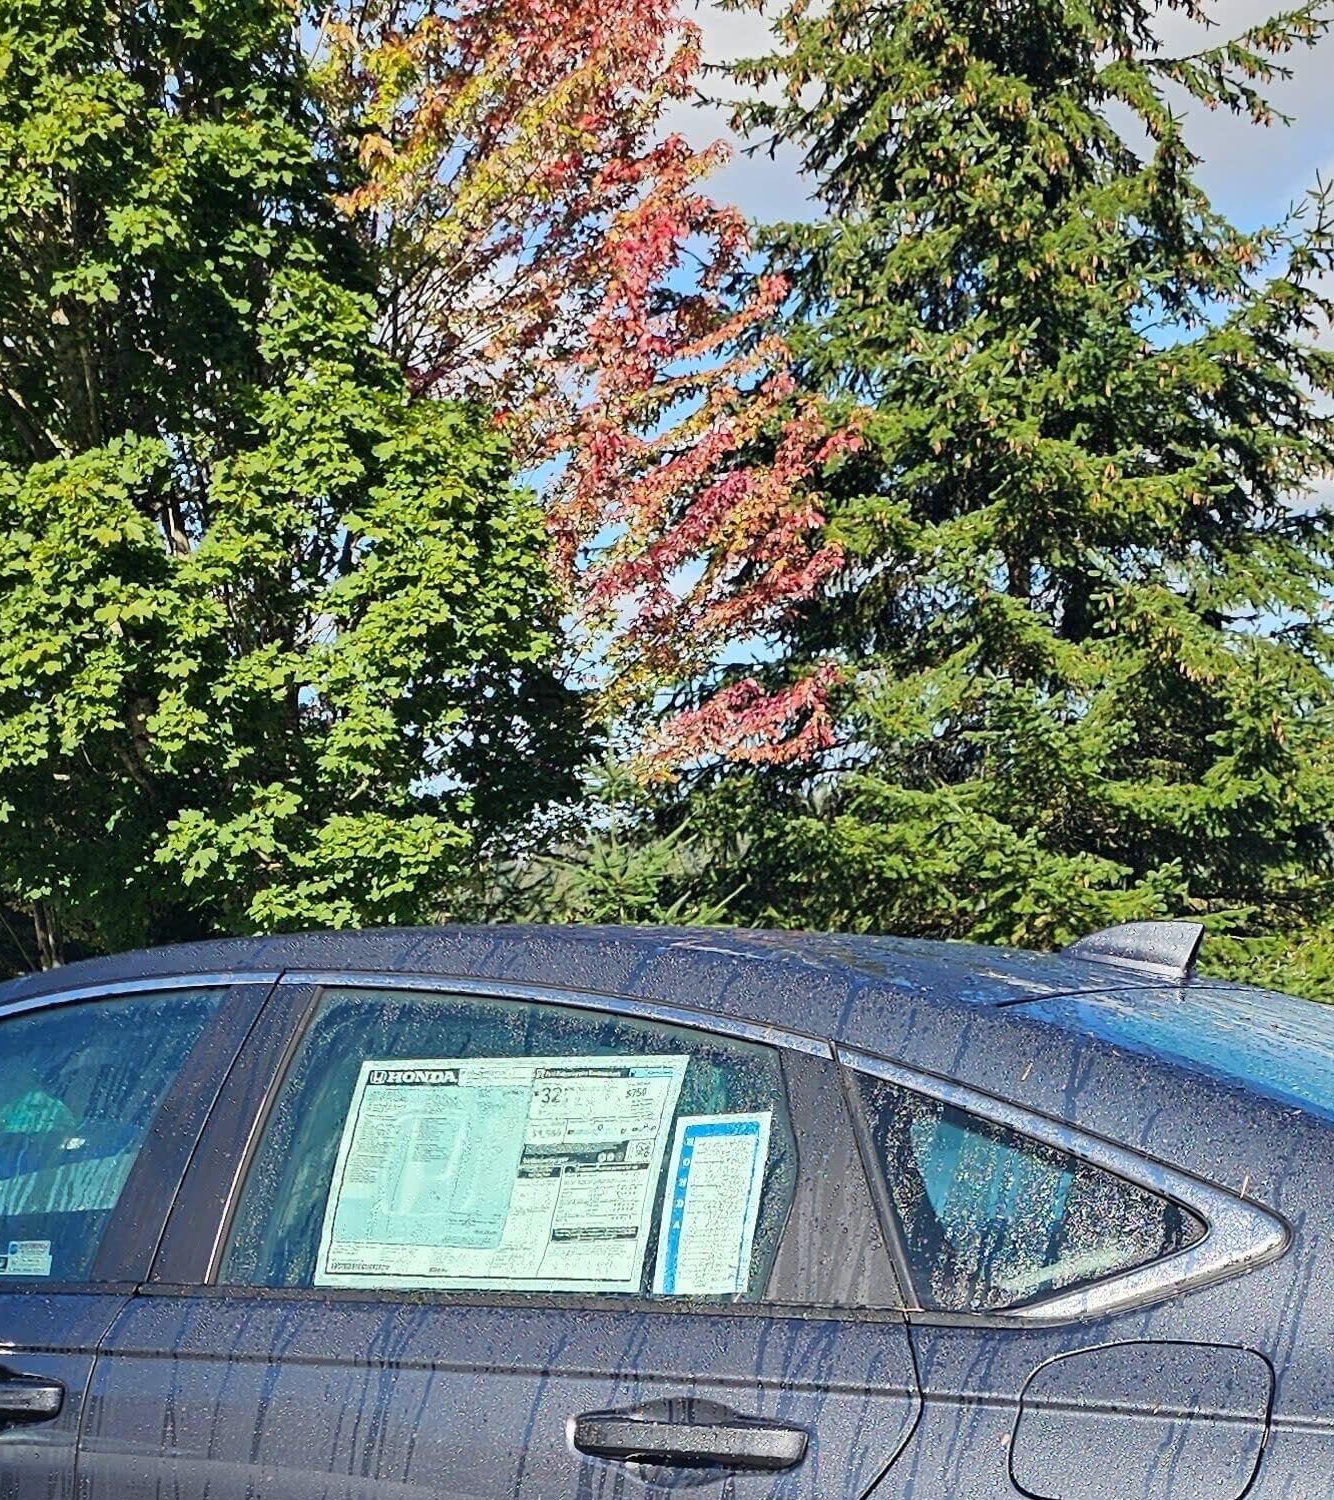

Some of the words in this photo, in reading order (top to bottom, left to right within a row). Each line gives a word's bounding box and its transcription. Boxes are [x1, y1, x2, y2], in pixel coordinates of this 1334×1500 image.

[387, 1070, 458, 1084] HONDA
[541, 1087, 563, 1104] 32
[672, 1137, 695, 1229] HONDA
